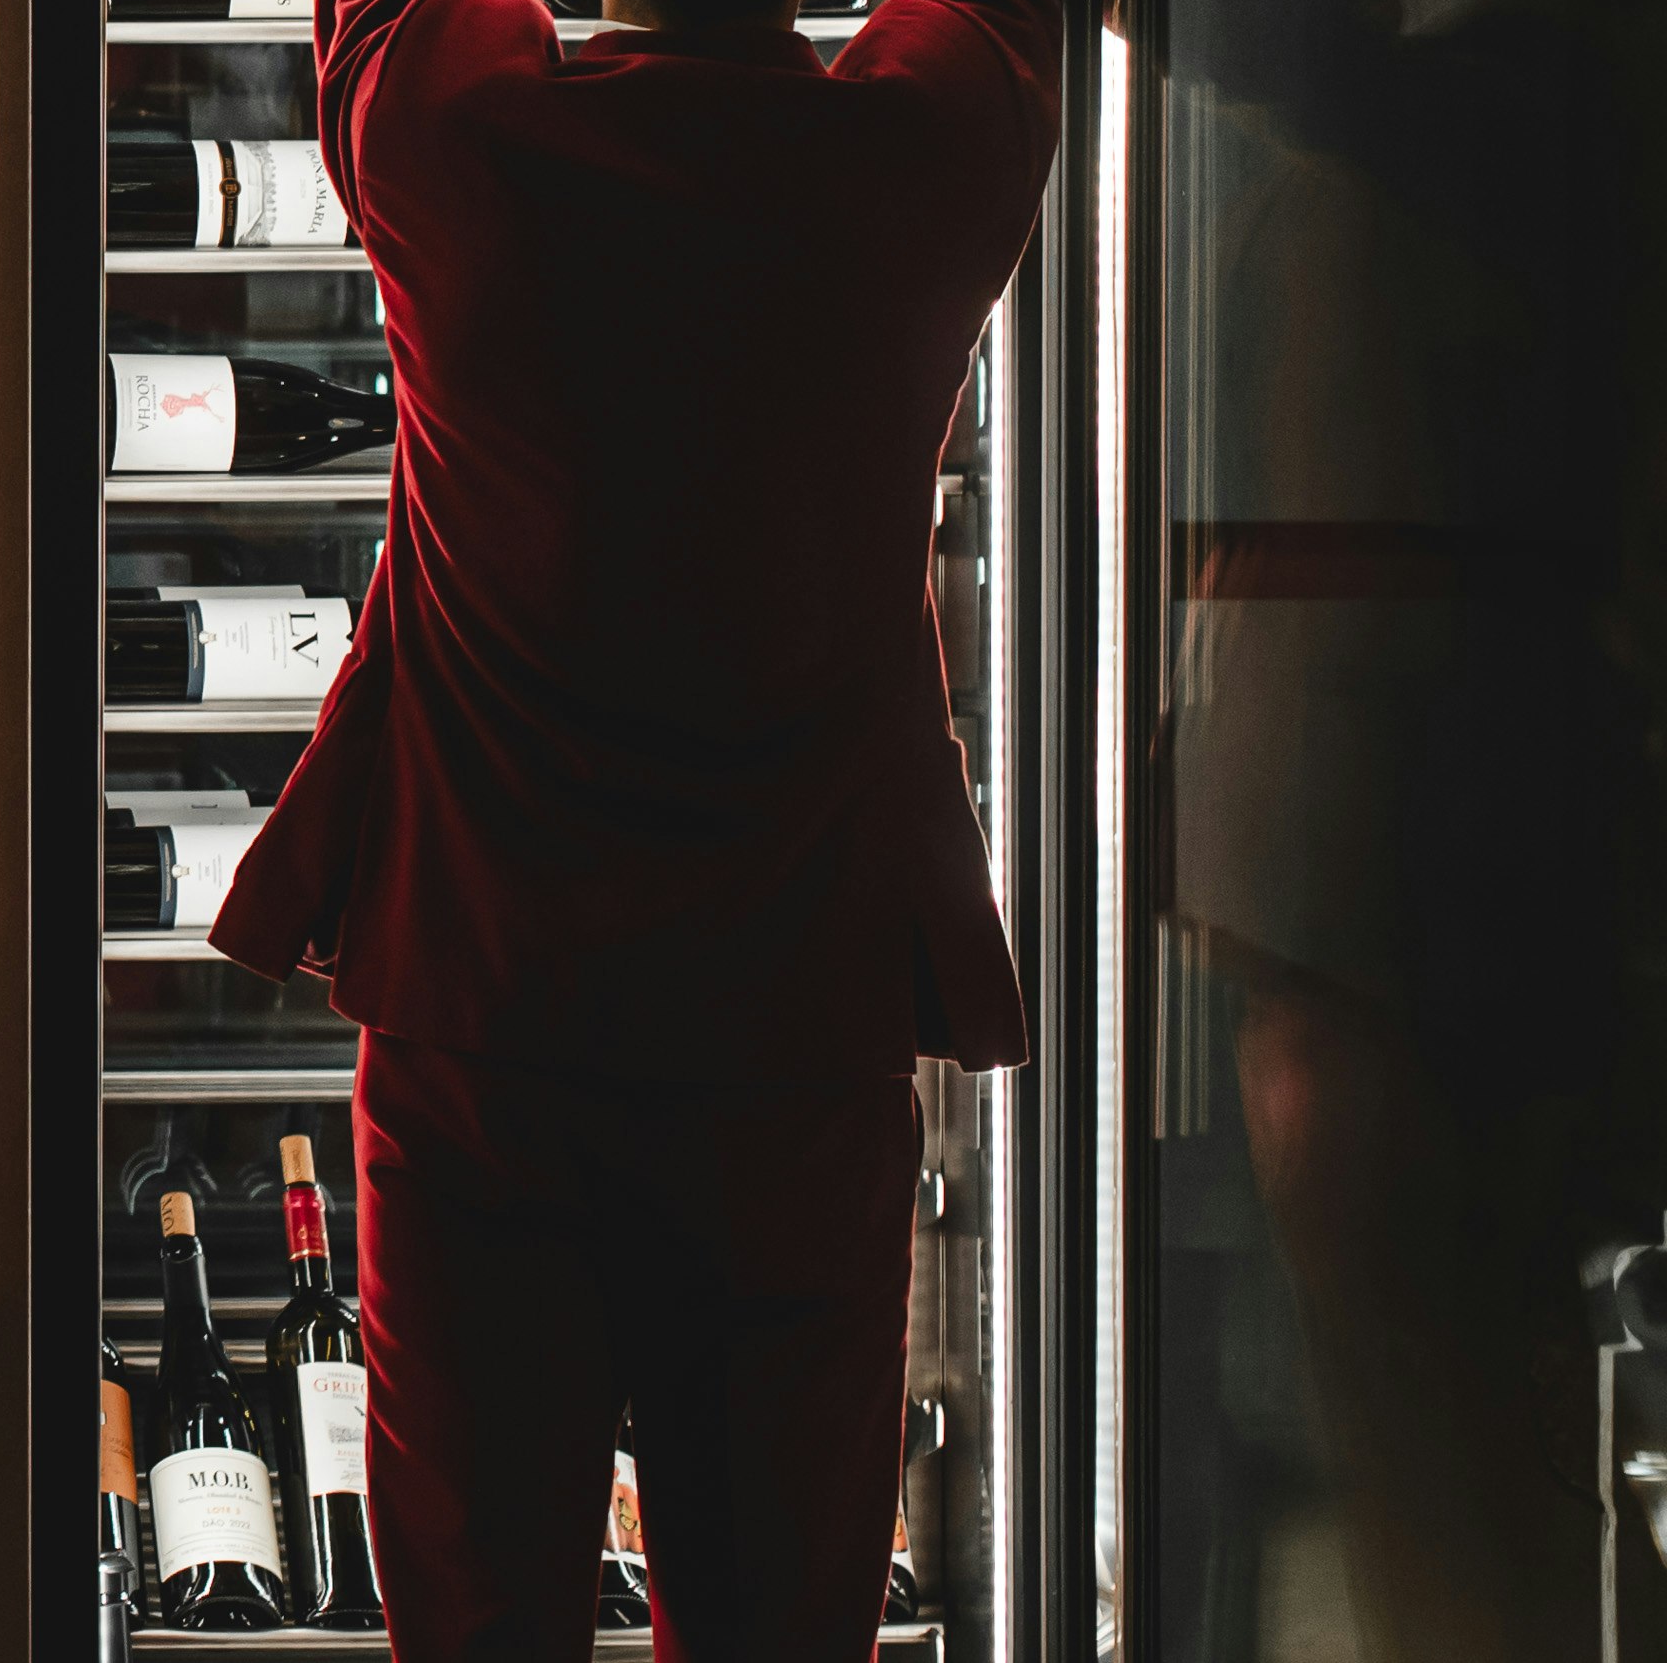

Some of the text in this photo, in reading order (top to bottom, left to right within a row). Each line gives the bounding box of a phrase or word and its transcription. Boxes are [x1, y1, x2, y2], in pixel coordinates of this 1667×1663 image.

[304, 148, 328, 235] DONA MARIA
[134, 374, 151, 432] ROCHA
[287, 610, 320, 669] LV
[186, 1469, 254, 1492] M.O.B.
[201, 1516, 226, 1529] DÃO
